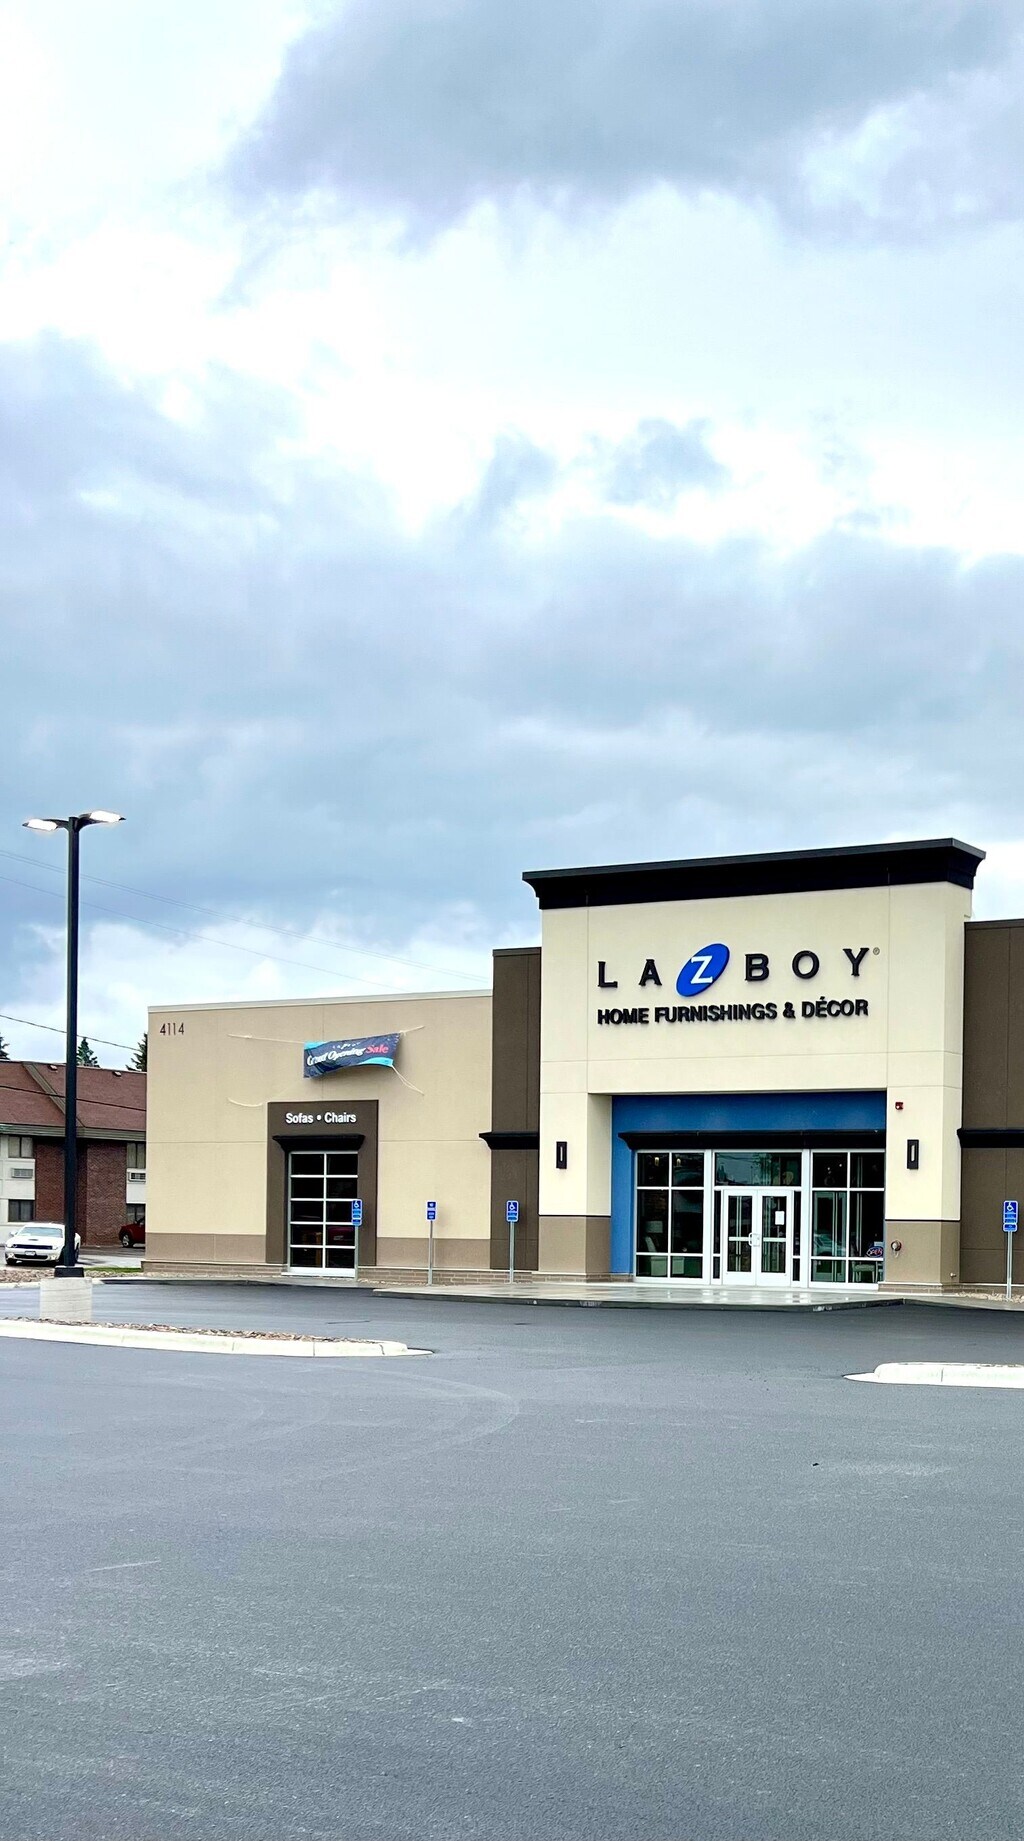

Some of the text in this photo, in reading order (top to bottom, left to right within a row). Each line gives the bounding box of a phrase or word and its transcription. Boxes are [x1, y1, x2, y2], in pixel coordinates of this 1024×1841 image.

[597, 996, 868, 1024] HOME FURNISHINGS & DÉCOR
[160, 1022, 184, 1035] 4114
[366, 1043, 389, 1054] Sale
[285, 1112, 314, 1124] Sofas
[324, 1112, 357, 1123] Chairs
